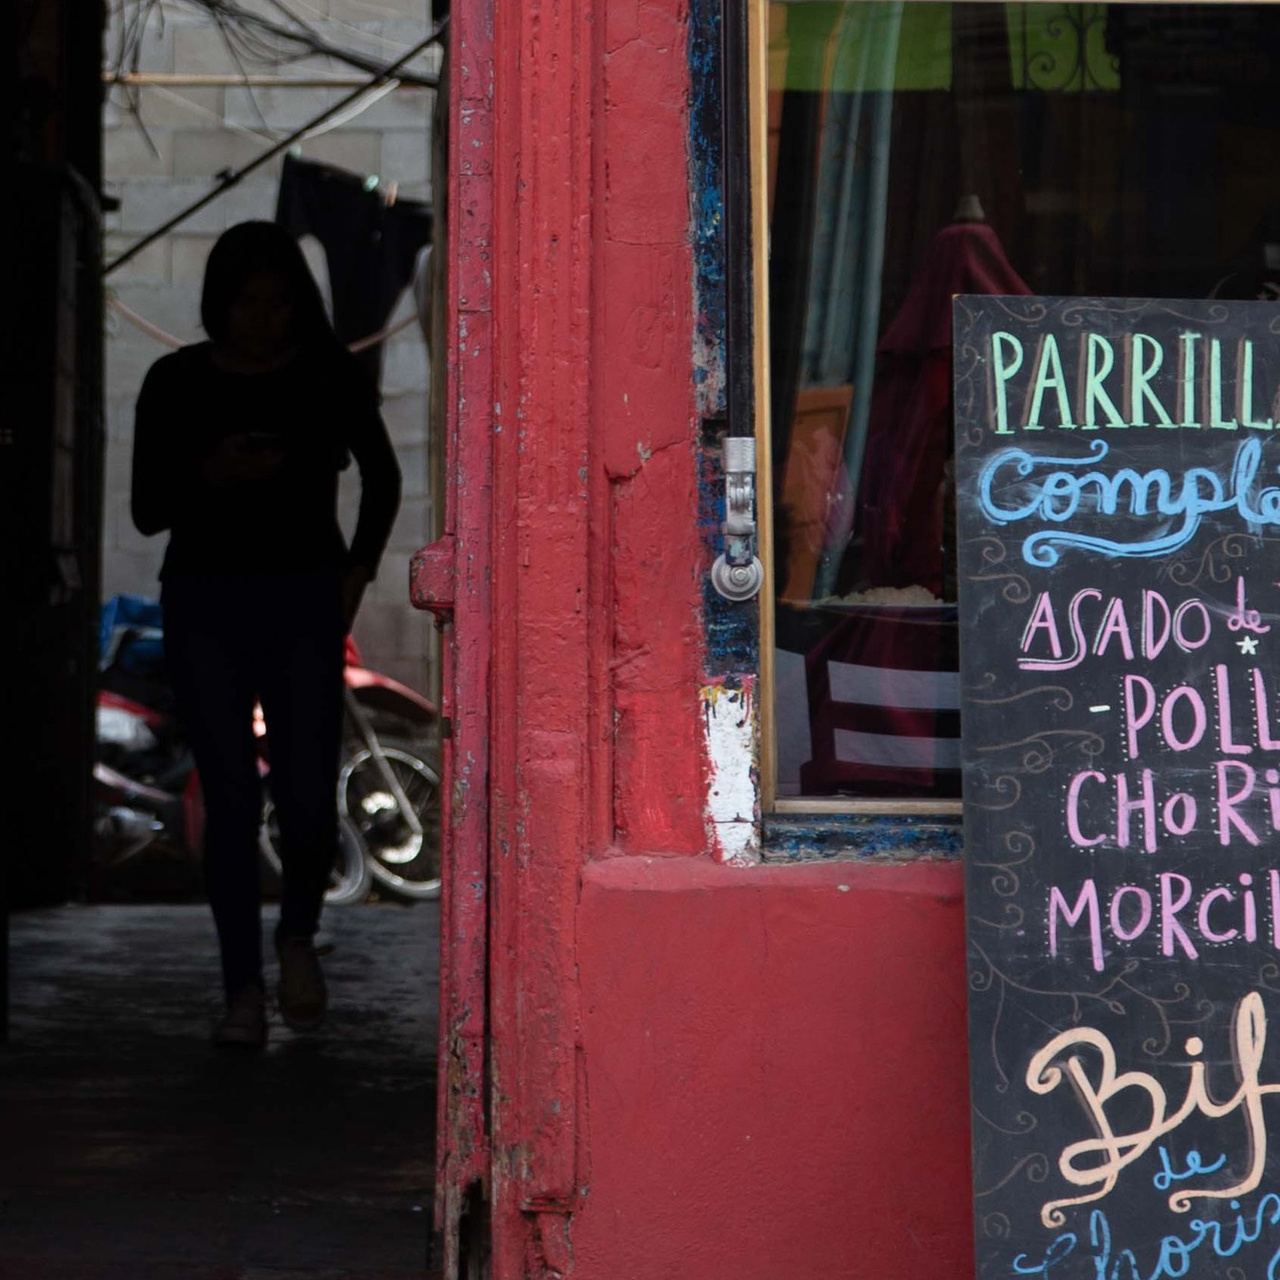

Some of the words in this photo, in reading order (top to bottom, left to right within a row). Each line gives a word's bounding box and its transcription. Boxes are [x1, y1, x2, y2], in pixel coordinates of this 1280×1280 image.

[990, 330, 1280, 434] PARRILL
[1018, 588, 1212, 671] ASADO
[1227, 575, 1271, 634] de
[1153, 1146, 1226, 1190] de
